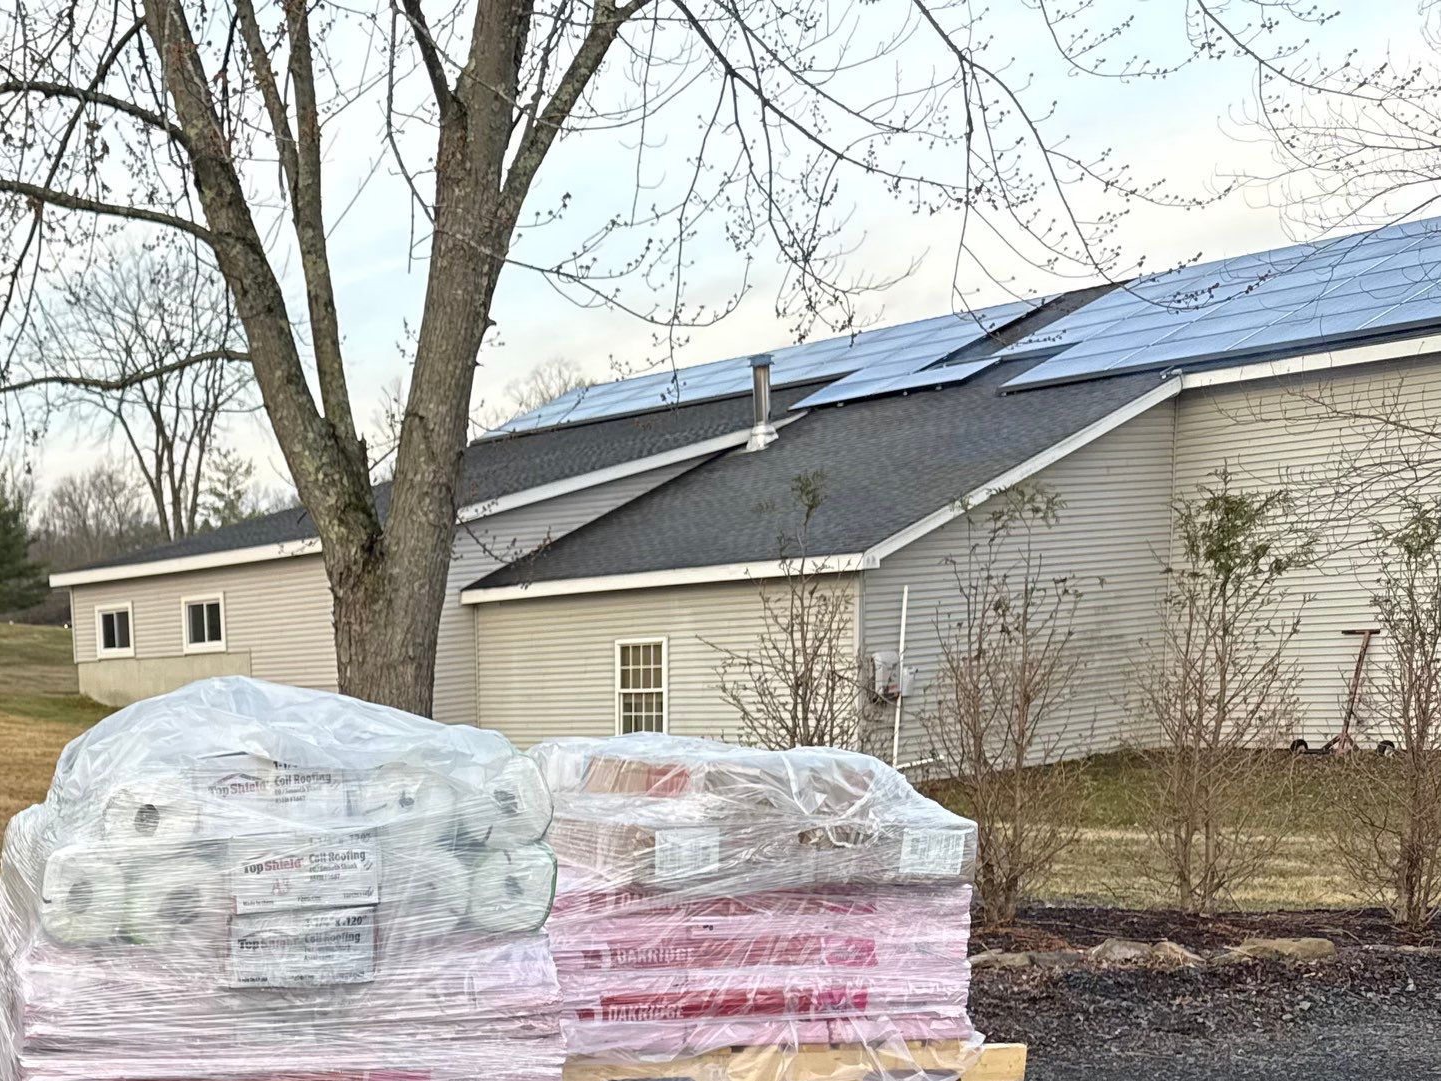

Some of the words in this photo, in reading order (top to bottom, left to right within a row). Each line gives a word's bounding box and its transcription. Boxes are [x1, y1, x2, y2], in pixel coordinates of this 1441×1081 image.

[294, 772, 331, 785] Roofing
[208, 787, 228, 797] Top
[231, 781, 266, 794] Shield
[329, 851, 365, 861] Roofing
[244, 863, 263, 874] Top
[265, 858, 302, 872] Shield
[238, 939, 259, 950] Top
